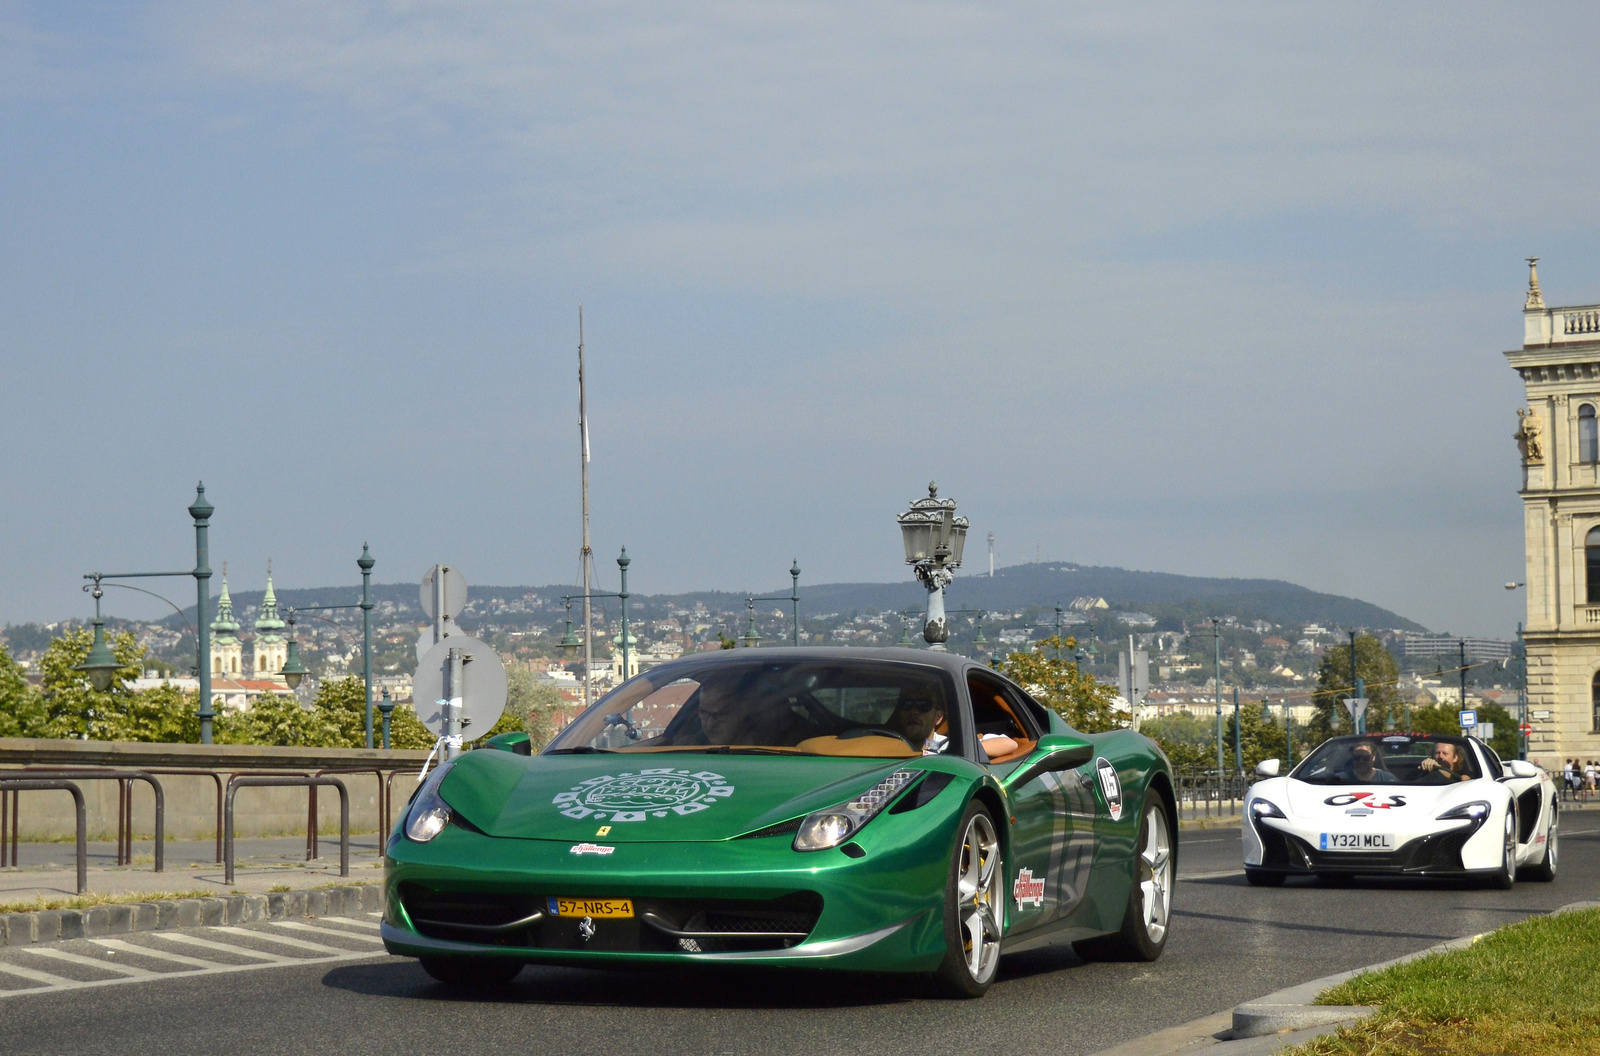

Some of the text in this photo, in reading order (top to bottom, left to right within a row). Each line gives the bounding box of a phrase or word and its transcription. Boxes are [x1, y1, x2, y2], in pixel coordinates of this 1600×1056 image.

[1323, 792, 1407, 809] G4S
[1331, 834, 1390, 848] Y321 MCL
[572, 845, 614, 855] challenge
[1015, 878, 1043, 907] challenge
[560, 901, 631, 915] 57-NRS-4
